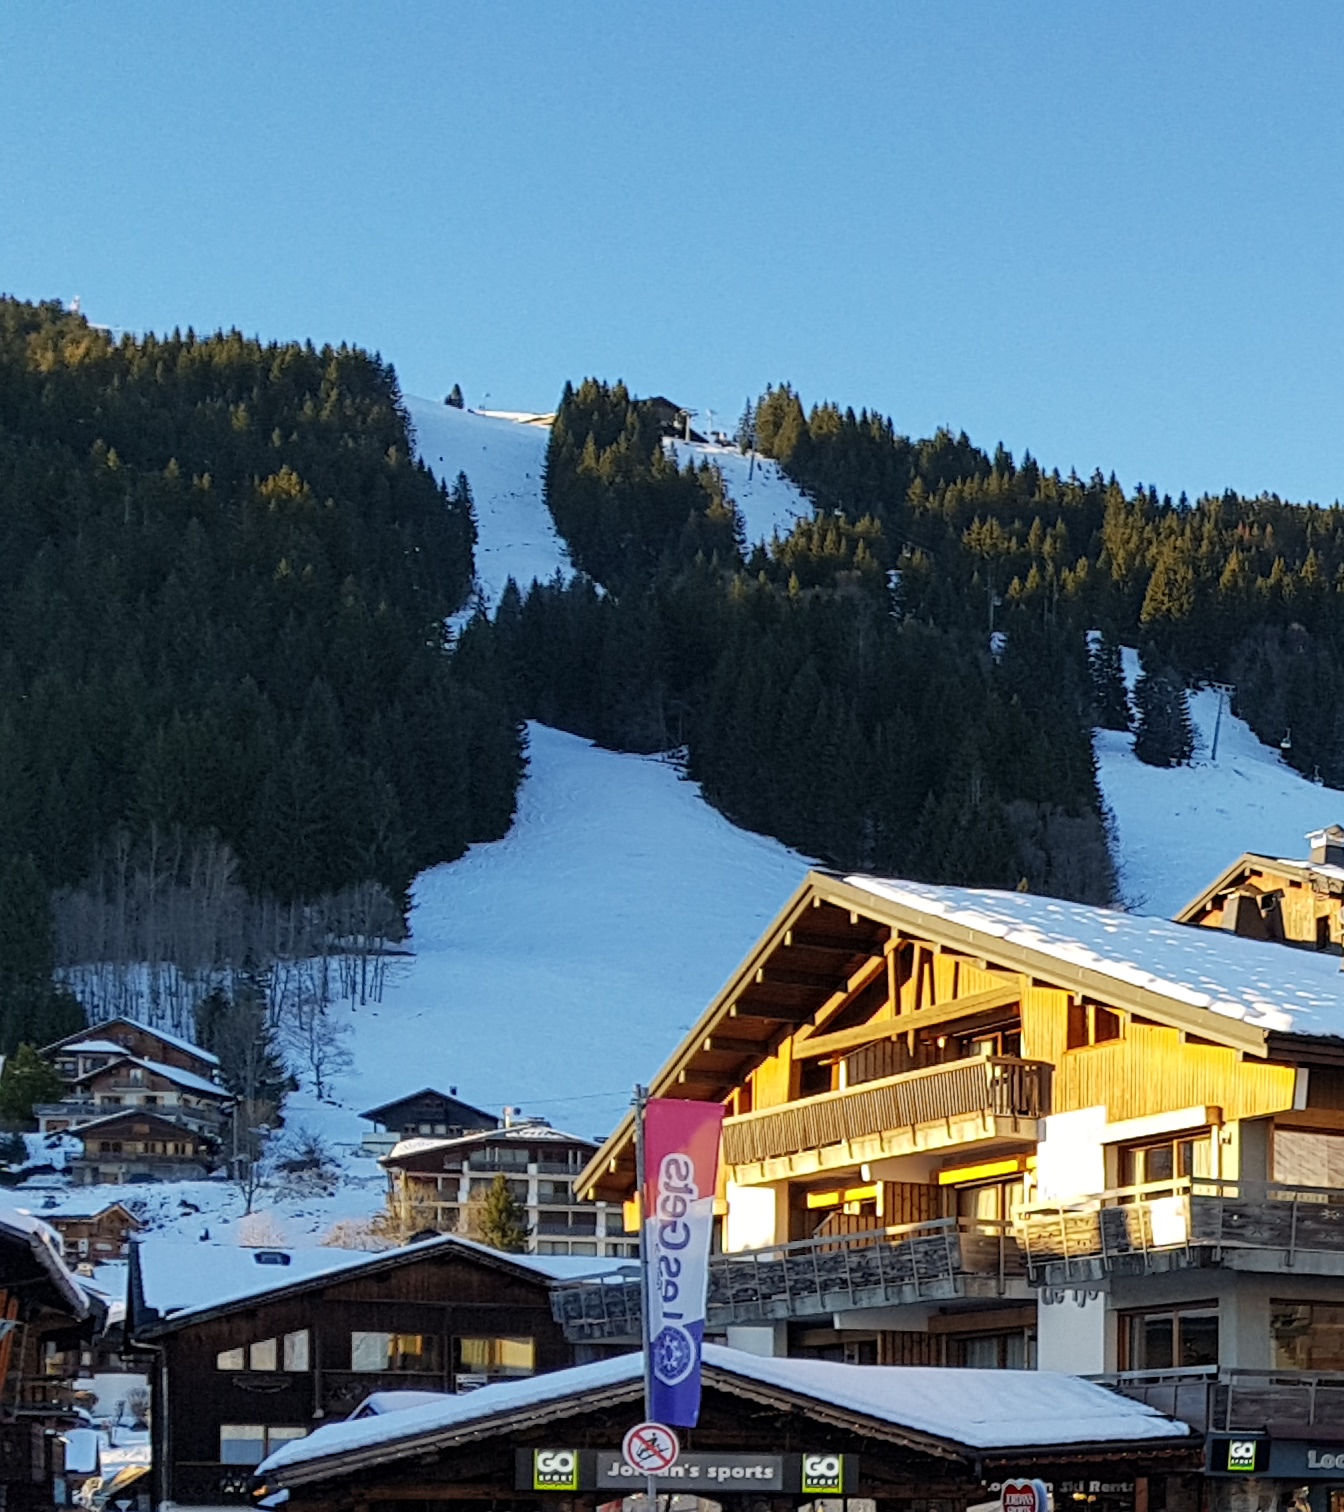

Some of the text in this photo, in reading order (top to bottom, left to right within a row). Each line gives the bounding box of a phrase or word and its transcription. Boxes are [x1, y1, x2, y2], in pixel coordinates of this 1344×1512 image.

[1230, 1442, 1254, 1458] GO
[538, 1451, 574, 1473] GO
[707, 1462, 774, 1481] sports
[805, 1456, 839, 1477] GO
